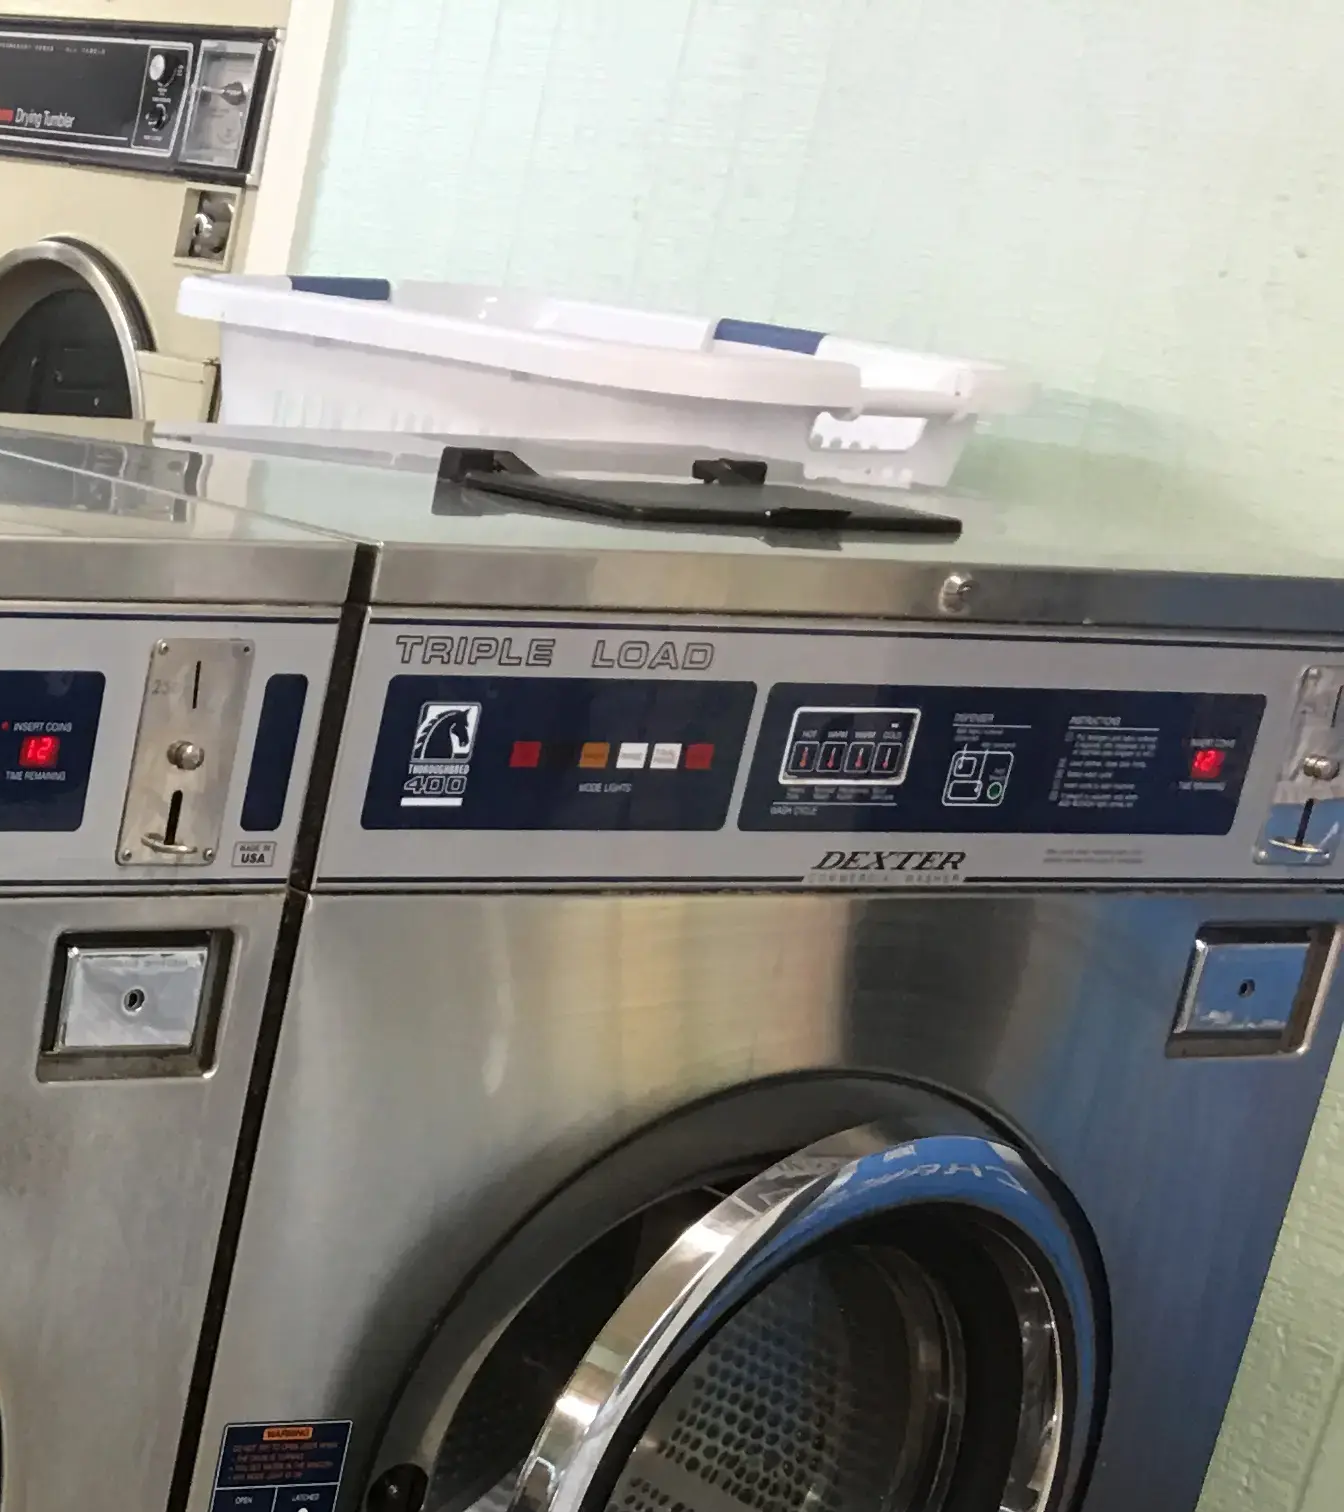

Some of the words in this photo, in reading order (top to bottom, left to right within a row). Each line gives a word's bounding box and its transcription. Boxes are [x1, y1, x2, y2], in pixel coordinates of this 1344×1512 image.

[15, 107, 42, 128] Drying
[44, 109, 75, 129] Tumbler
[395, 635, 556, 667] TRIPLE
[591, 640, 715, 671] LOAD
[14, 722, 45, 731] INSERT
[46, 722, 72, 732] COINS
[28, 737, 52, 760] 12
[6, 771, 23, 780] TIME
[24, 771, 66, 781] REMAINING
[403, 775, 467, 795] 400
[241, 853, 265, 864] USA
[810, 851, 966, 870] DEXTER
[235, 1496, 253, 1504] OPEN
